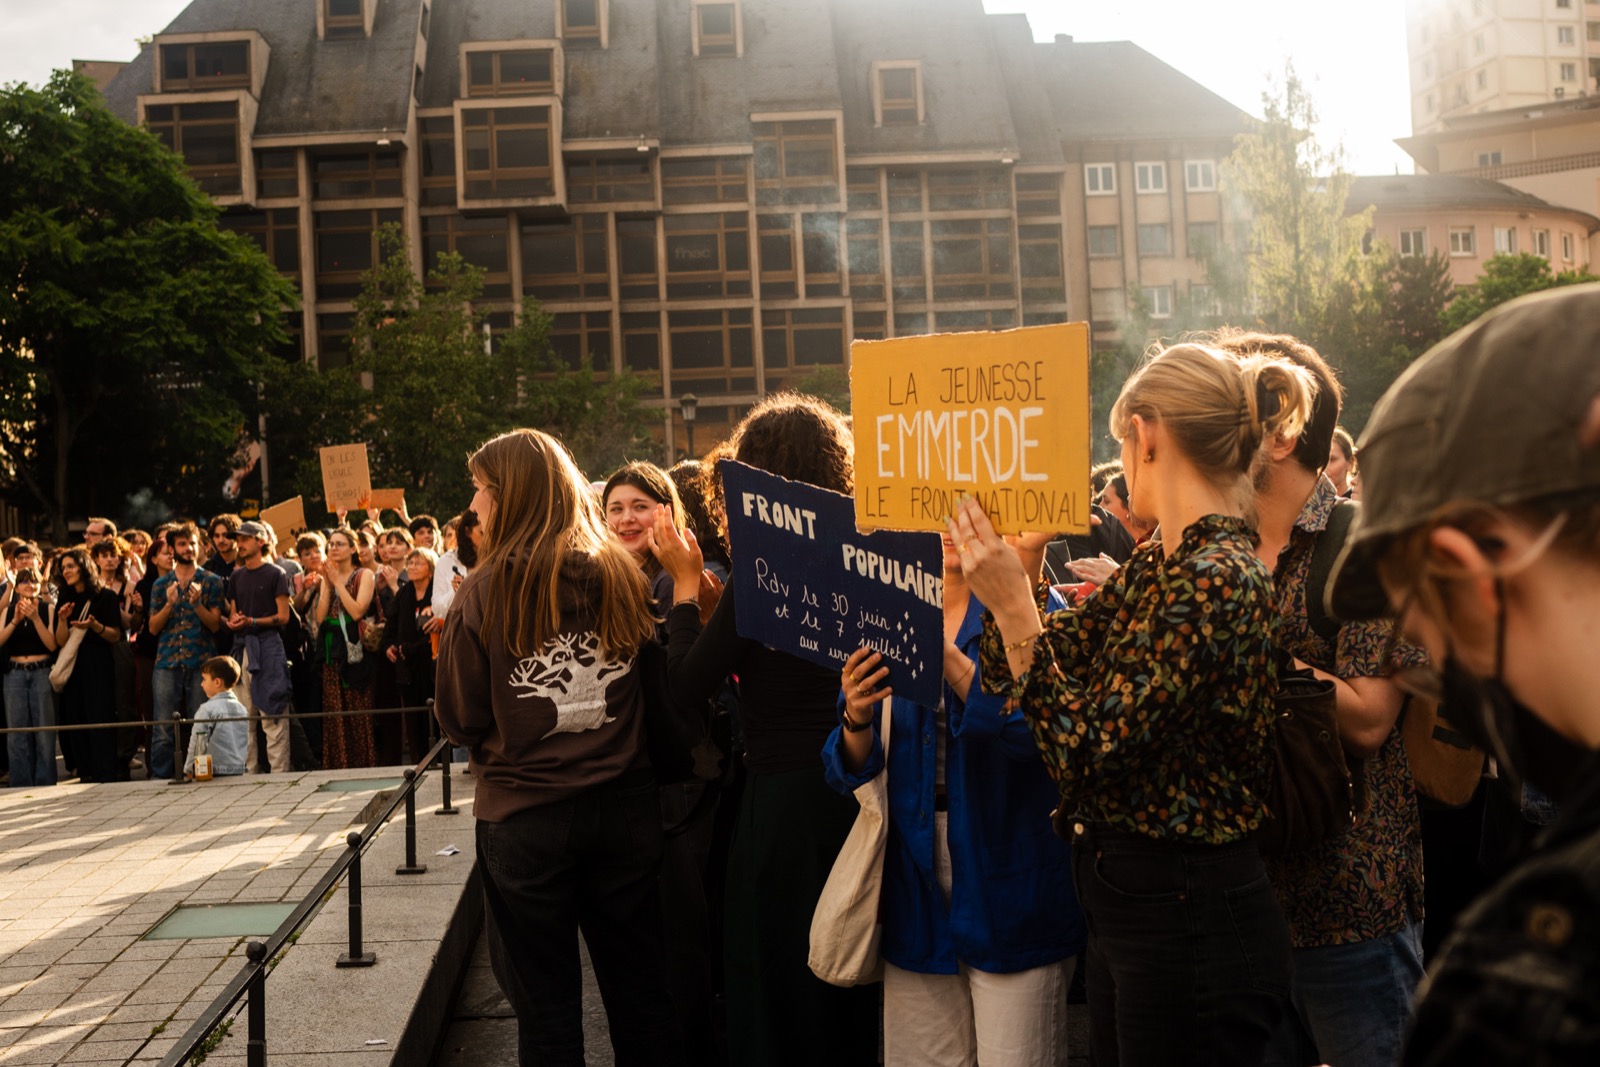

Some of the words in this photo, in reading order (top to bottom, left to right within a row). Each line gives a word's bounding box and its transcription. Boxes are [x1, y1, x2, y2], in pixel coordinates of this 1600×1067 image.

[675, 247, 711, 259] fnac
[888, 372, 918, 406] LA
[939, 361, 1046, 404] JEUNESSE
[340, 451, 356, 464] LES
[876, 406, 1049, 484] EMMERDE
[741, 491, 817, 540] FRONT
[865, 486, 891, 518] LE
[911, 486, 966, 523] FRONT
[975, 487, 1086, 527] NATIONAL
[755, 557, 790, 597] Rdv
[801, 584, 820, 608] le
[831, 592, 849, 616] 30
[857, 606, 891, 631] juin
[775, 603, 790, 619] et
[801, 611, 822, 631] le
[836, 620, 844, 638] 7
[857, 633, 902, 662] juillet
[799, 635, 819, 652] aux
[828, 647, 849, 662] urn
